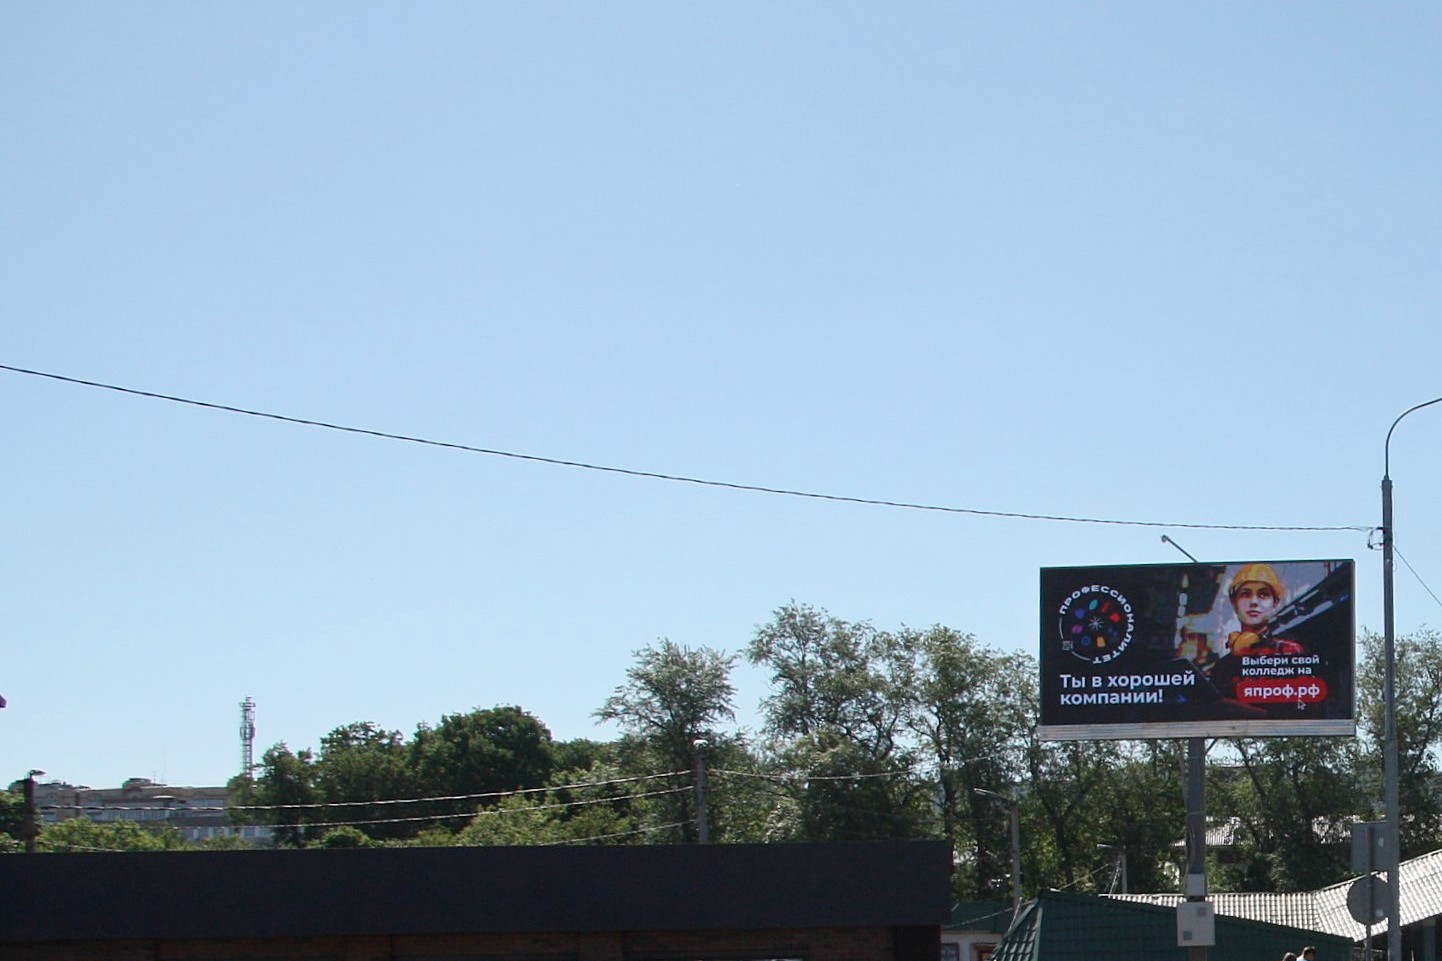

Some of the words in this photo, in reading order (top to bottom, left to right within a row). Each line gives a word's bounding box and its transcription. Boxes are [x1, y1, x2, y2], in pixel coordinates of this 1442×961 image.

[1059, 584, 1135, 664] ПРОФЕССИОНАЛИТЕТ
[1242, 655, 1289, 668] Выбери
[1292, 654, 1320, 665] свой
[1242, 666, 1294, 676] колледж
[1297, 666, 1312, 675] на
[1059, 674, 1086, 688] Ты
[1092, 675, 1103, 687] в
[1108, 670, 1195, 690] хорошей
[1060, 689, 1164, 705] компании!
[1244, 684, 1320, 698] япроф.рф
